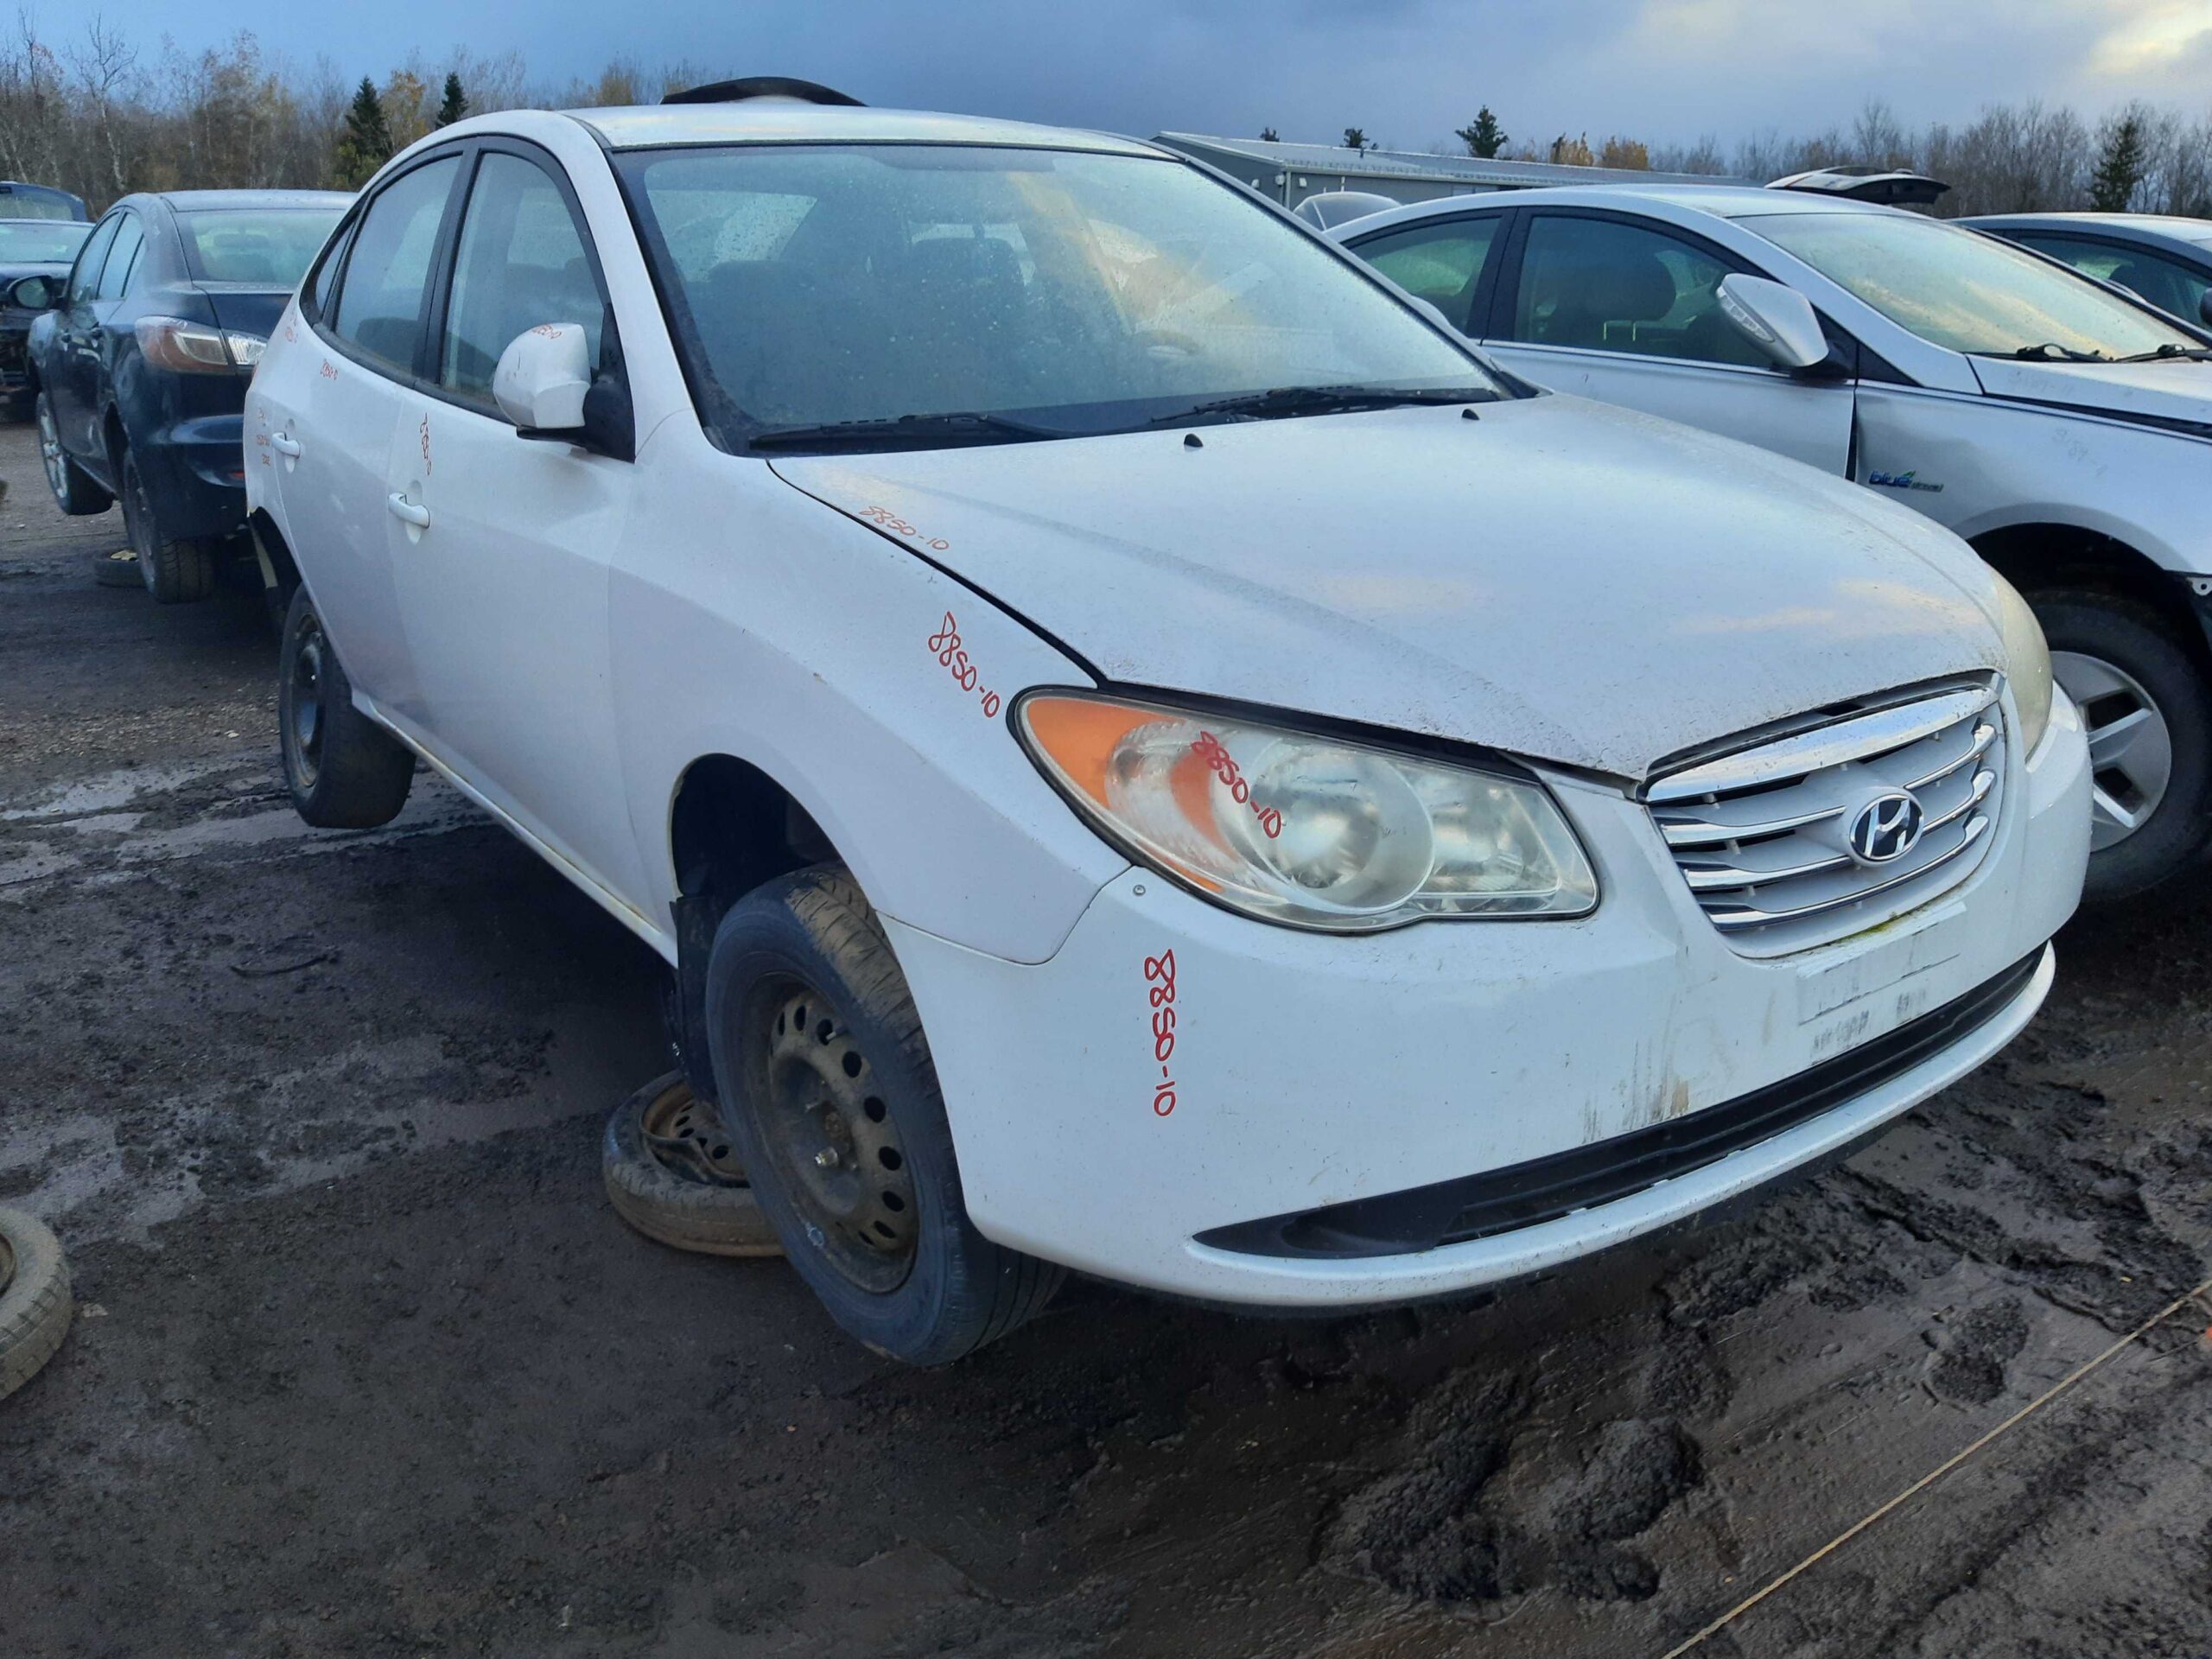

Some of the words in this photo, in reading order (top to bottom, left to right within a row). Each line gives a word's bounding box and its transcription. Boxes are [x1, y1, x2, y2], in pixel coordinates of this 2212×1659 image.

[927, 610, 1001, 718] 8850-10
[1191, 730, 1282, 838] 8850-10
[1144, 949, 1176, 1116] 8850-10
